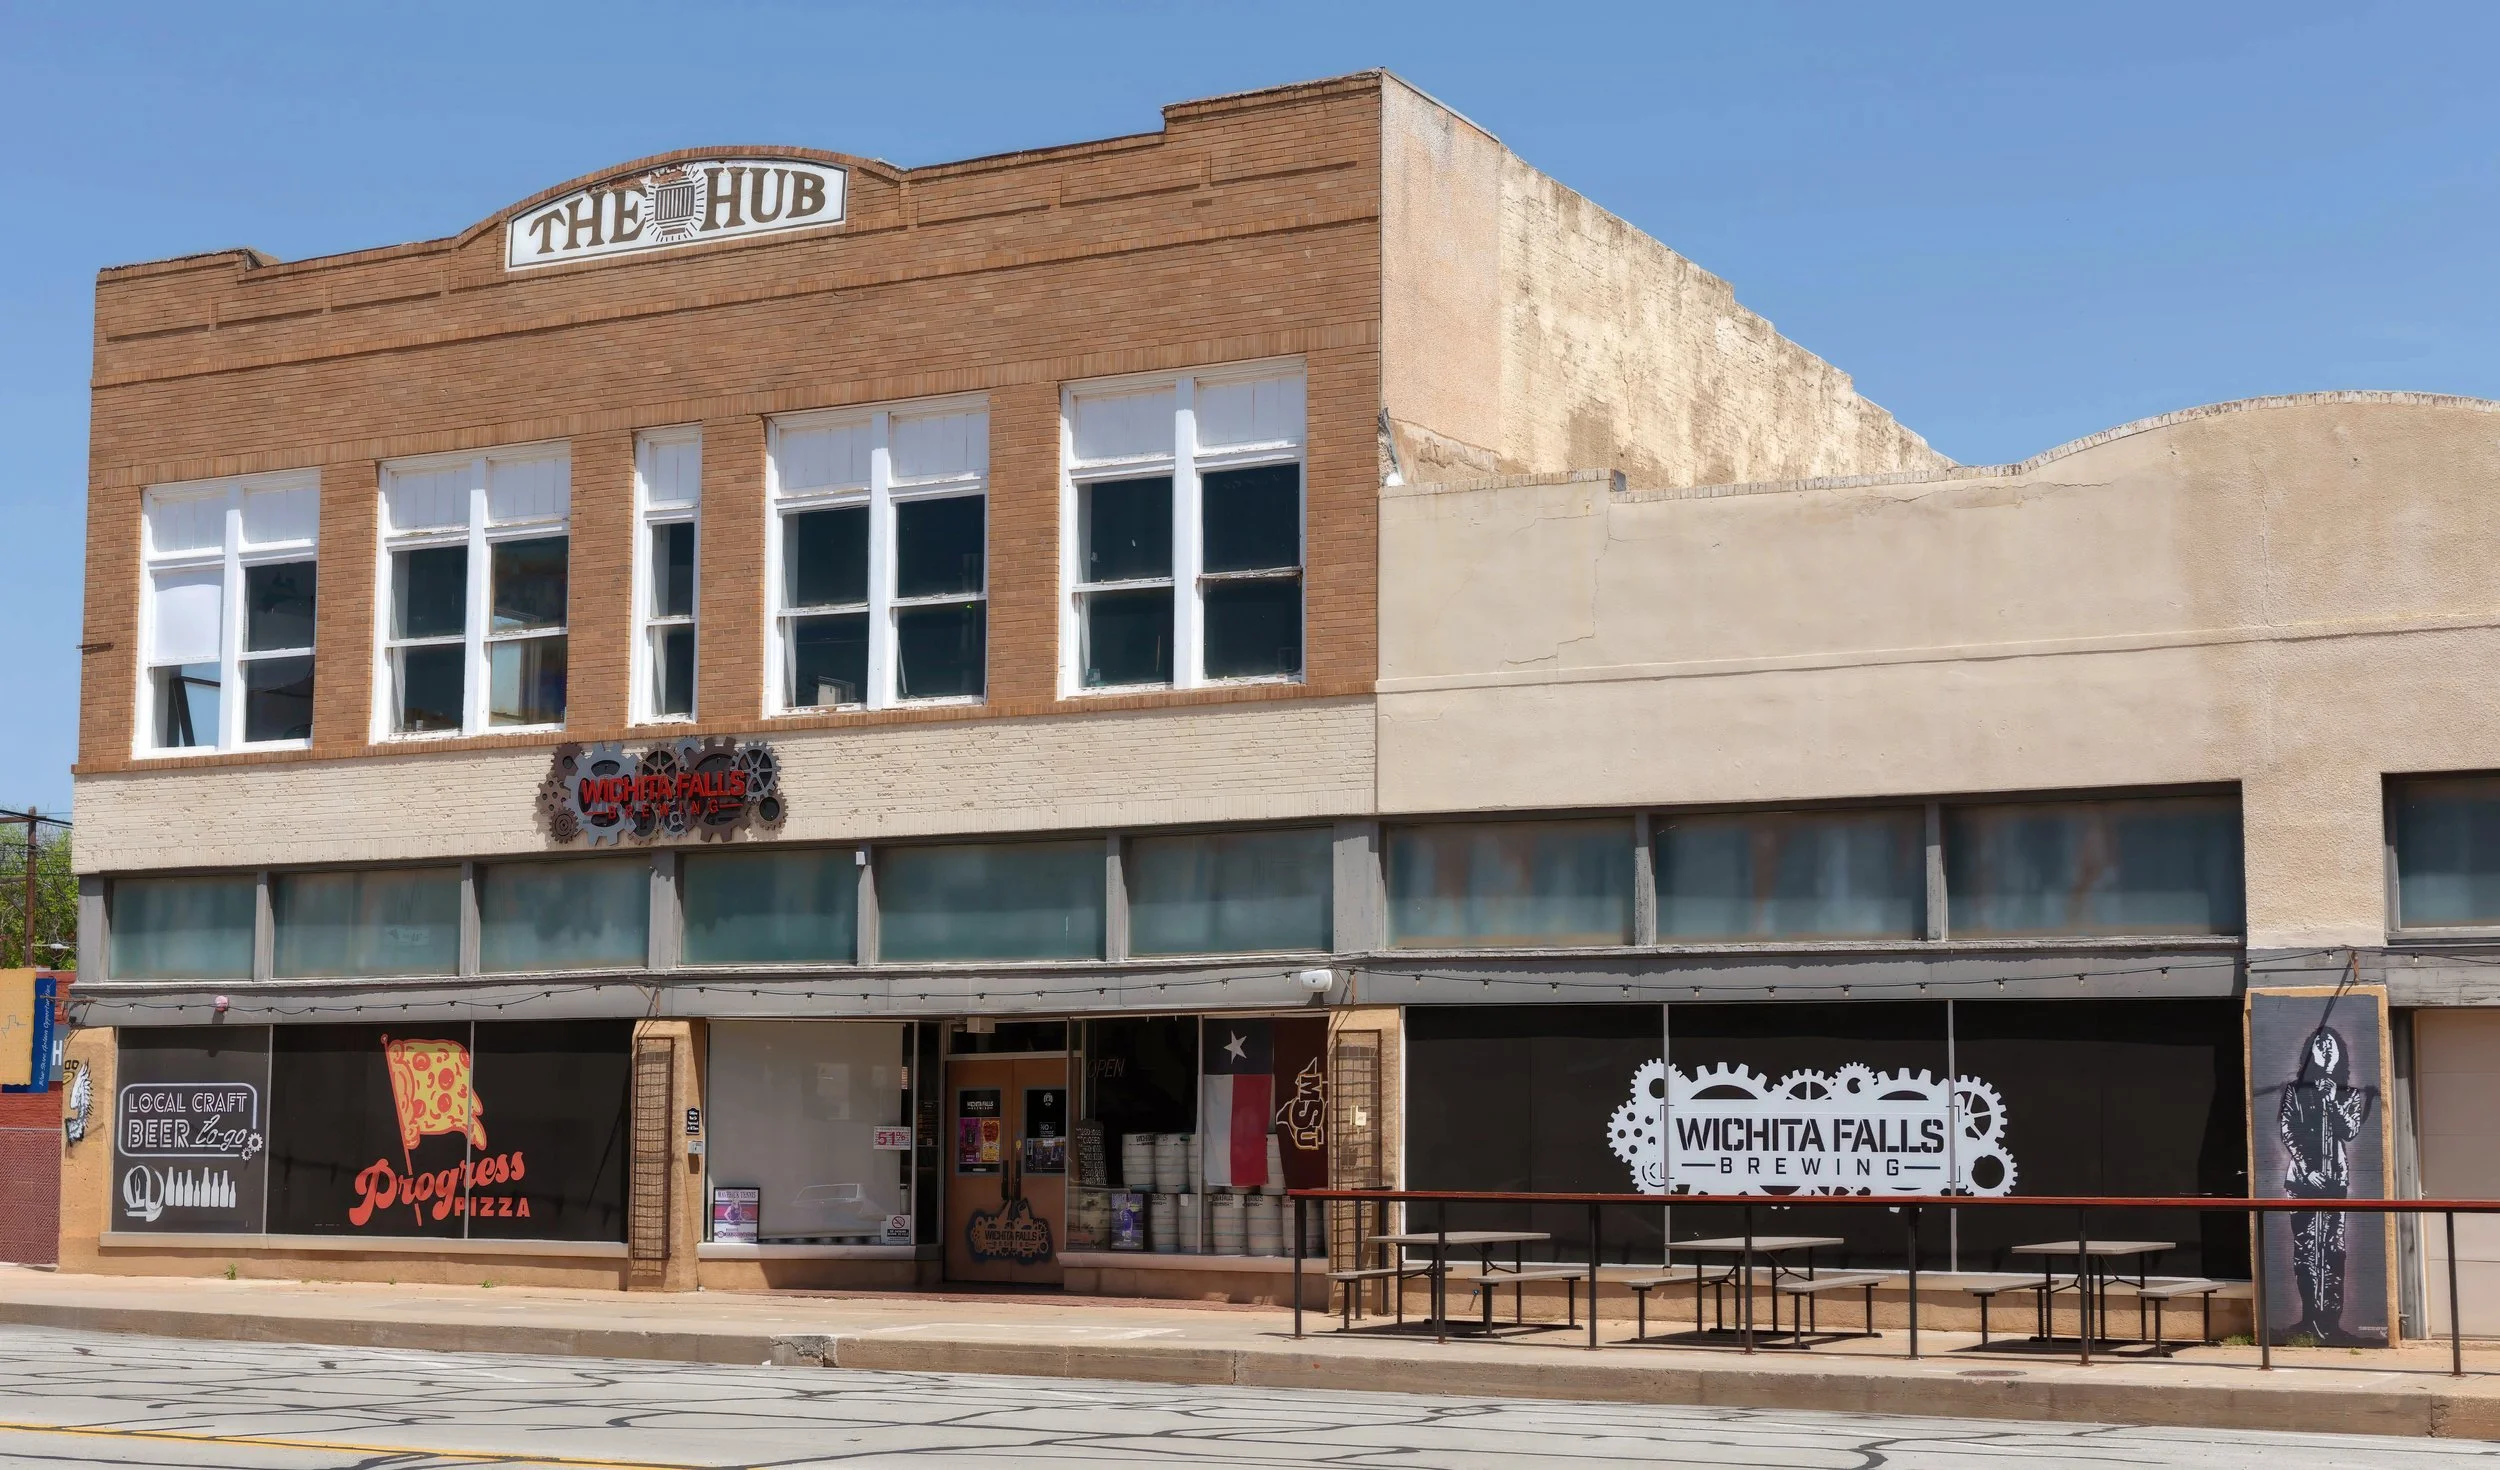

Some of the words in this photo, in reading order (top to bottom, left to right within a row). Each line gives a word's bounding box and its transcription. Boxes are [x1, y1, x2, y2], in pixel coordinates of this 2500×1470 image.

[528, 185, 648, 255] THE
[700, 166, 826, 232] HUB
[580, 775, 673, 804] WICHITA
[676, 770, 746, 798] FALLS
[607, 801, 720, 820] BREWING
[52, 1040, 63, 1066] H
[1087, 1058, 1126, 1079] OPEN
[128, 1093, 186, 1113] LOCAL
[192, 1093, 248, 1113] CRAFT
[1290, 1073, 1324, 1150] MSU
[128, 1119, 190, 1148] BEER
[878, 1131, 906, 1146] 51%
[1676, 1117, 1825, 1154] WICHITA
[1833, 1117, 1946, 1154] FALLS
[1721, 1156, 1900, 1176] BREWING
[349, 1151, 525, 1226] Progress
[454, 1197, 531, 1217] PIZZA
[985, 1231, 1014, 1241] WICHITA
[1015, 1231, 1037, 1241] FALLS
